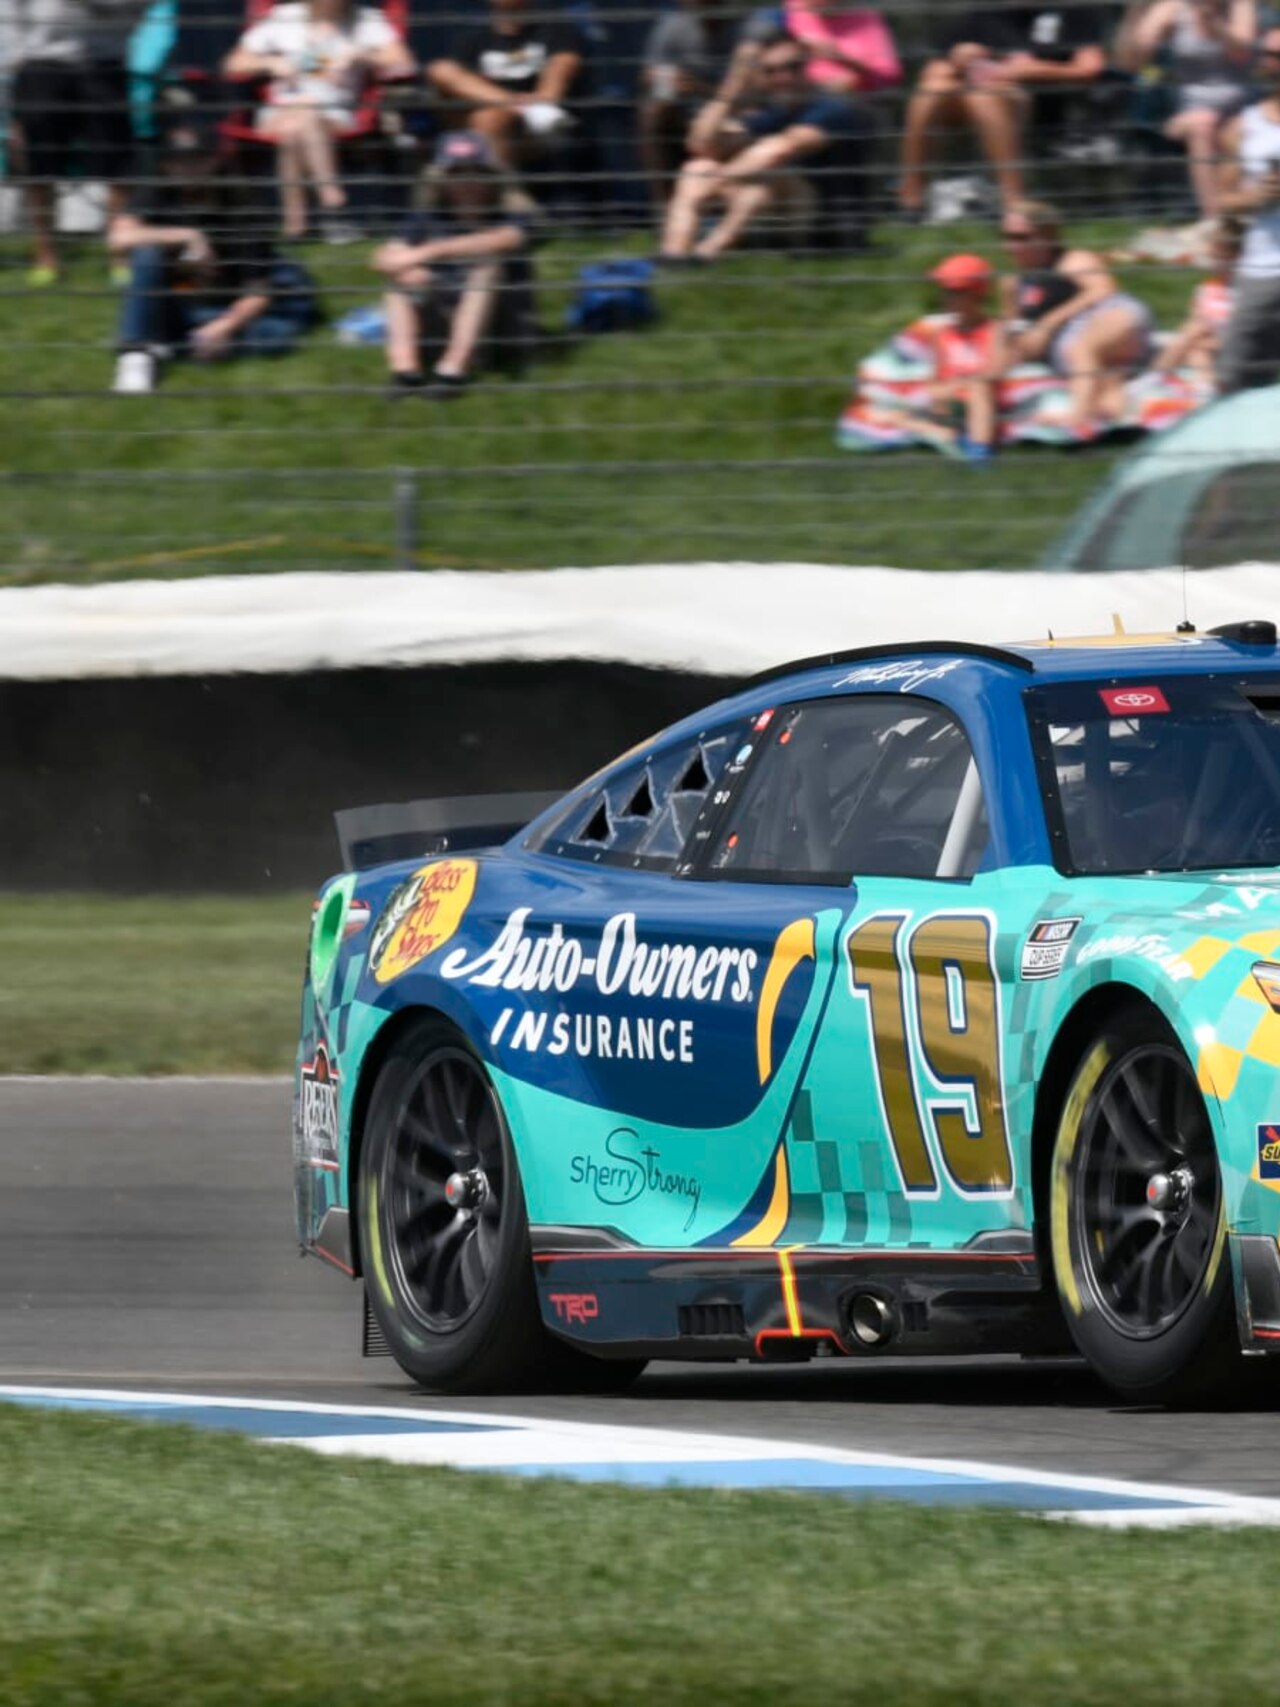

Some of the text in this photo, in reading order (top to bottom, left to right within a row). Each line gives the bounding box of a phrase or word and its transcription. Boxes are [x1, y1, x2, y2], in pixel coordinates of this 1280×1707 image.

[439, 906, 758, 1002] Auto-Owners
[489, 1008, 695, 1063] INSURANCE
[844, 908, 1016, 1200] 19
[549, 1292, 599, 1324] TRD
